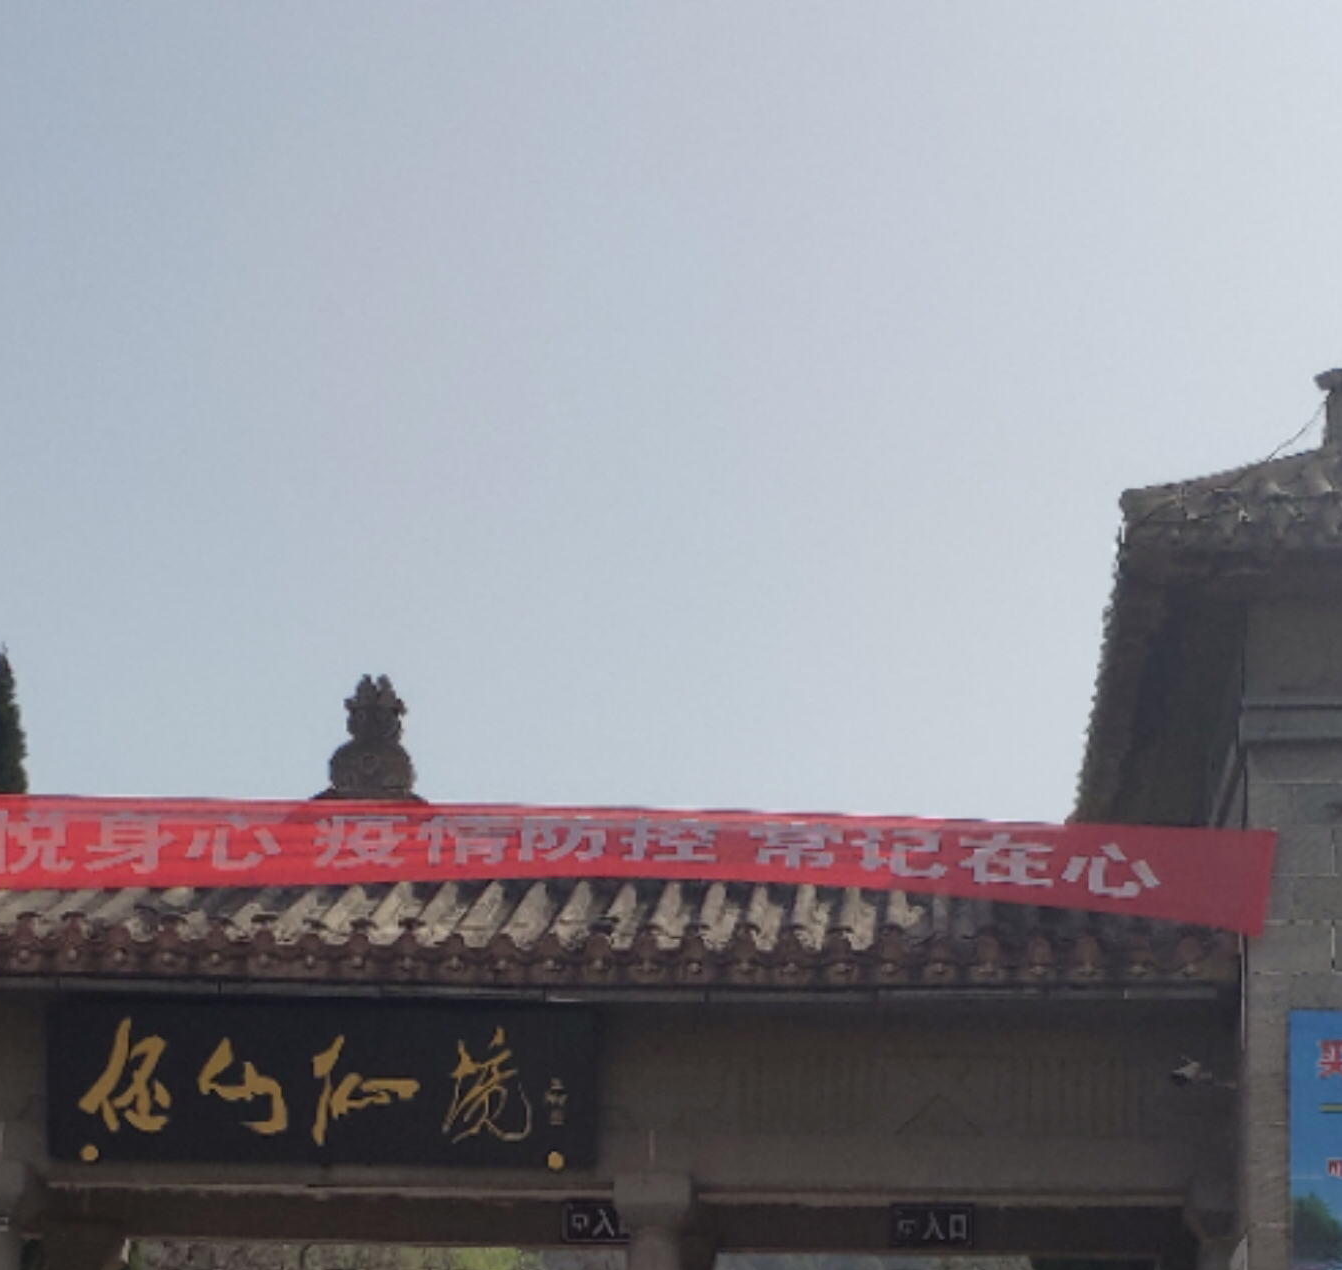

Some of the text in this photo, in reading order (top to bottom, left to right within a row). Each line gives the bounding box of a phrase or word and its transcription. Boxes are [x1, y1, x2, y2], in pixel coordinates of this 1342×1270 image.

[313, 814, 719, 870] 疫情防控
[747, 819, 1161, 901] 常记在心
[922, 1211, 967, 1240] 入口
